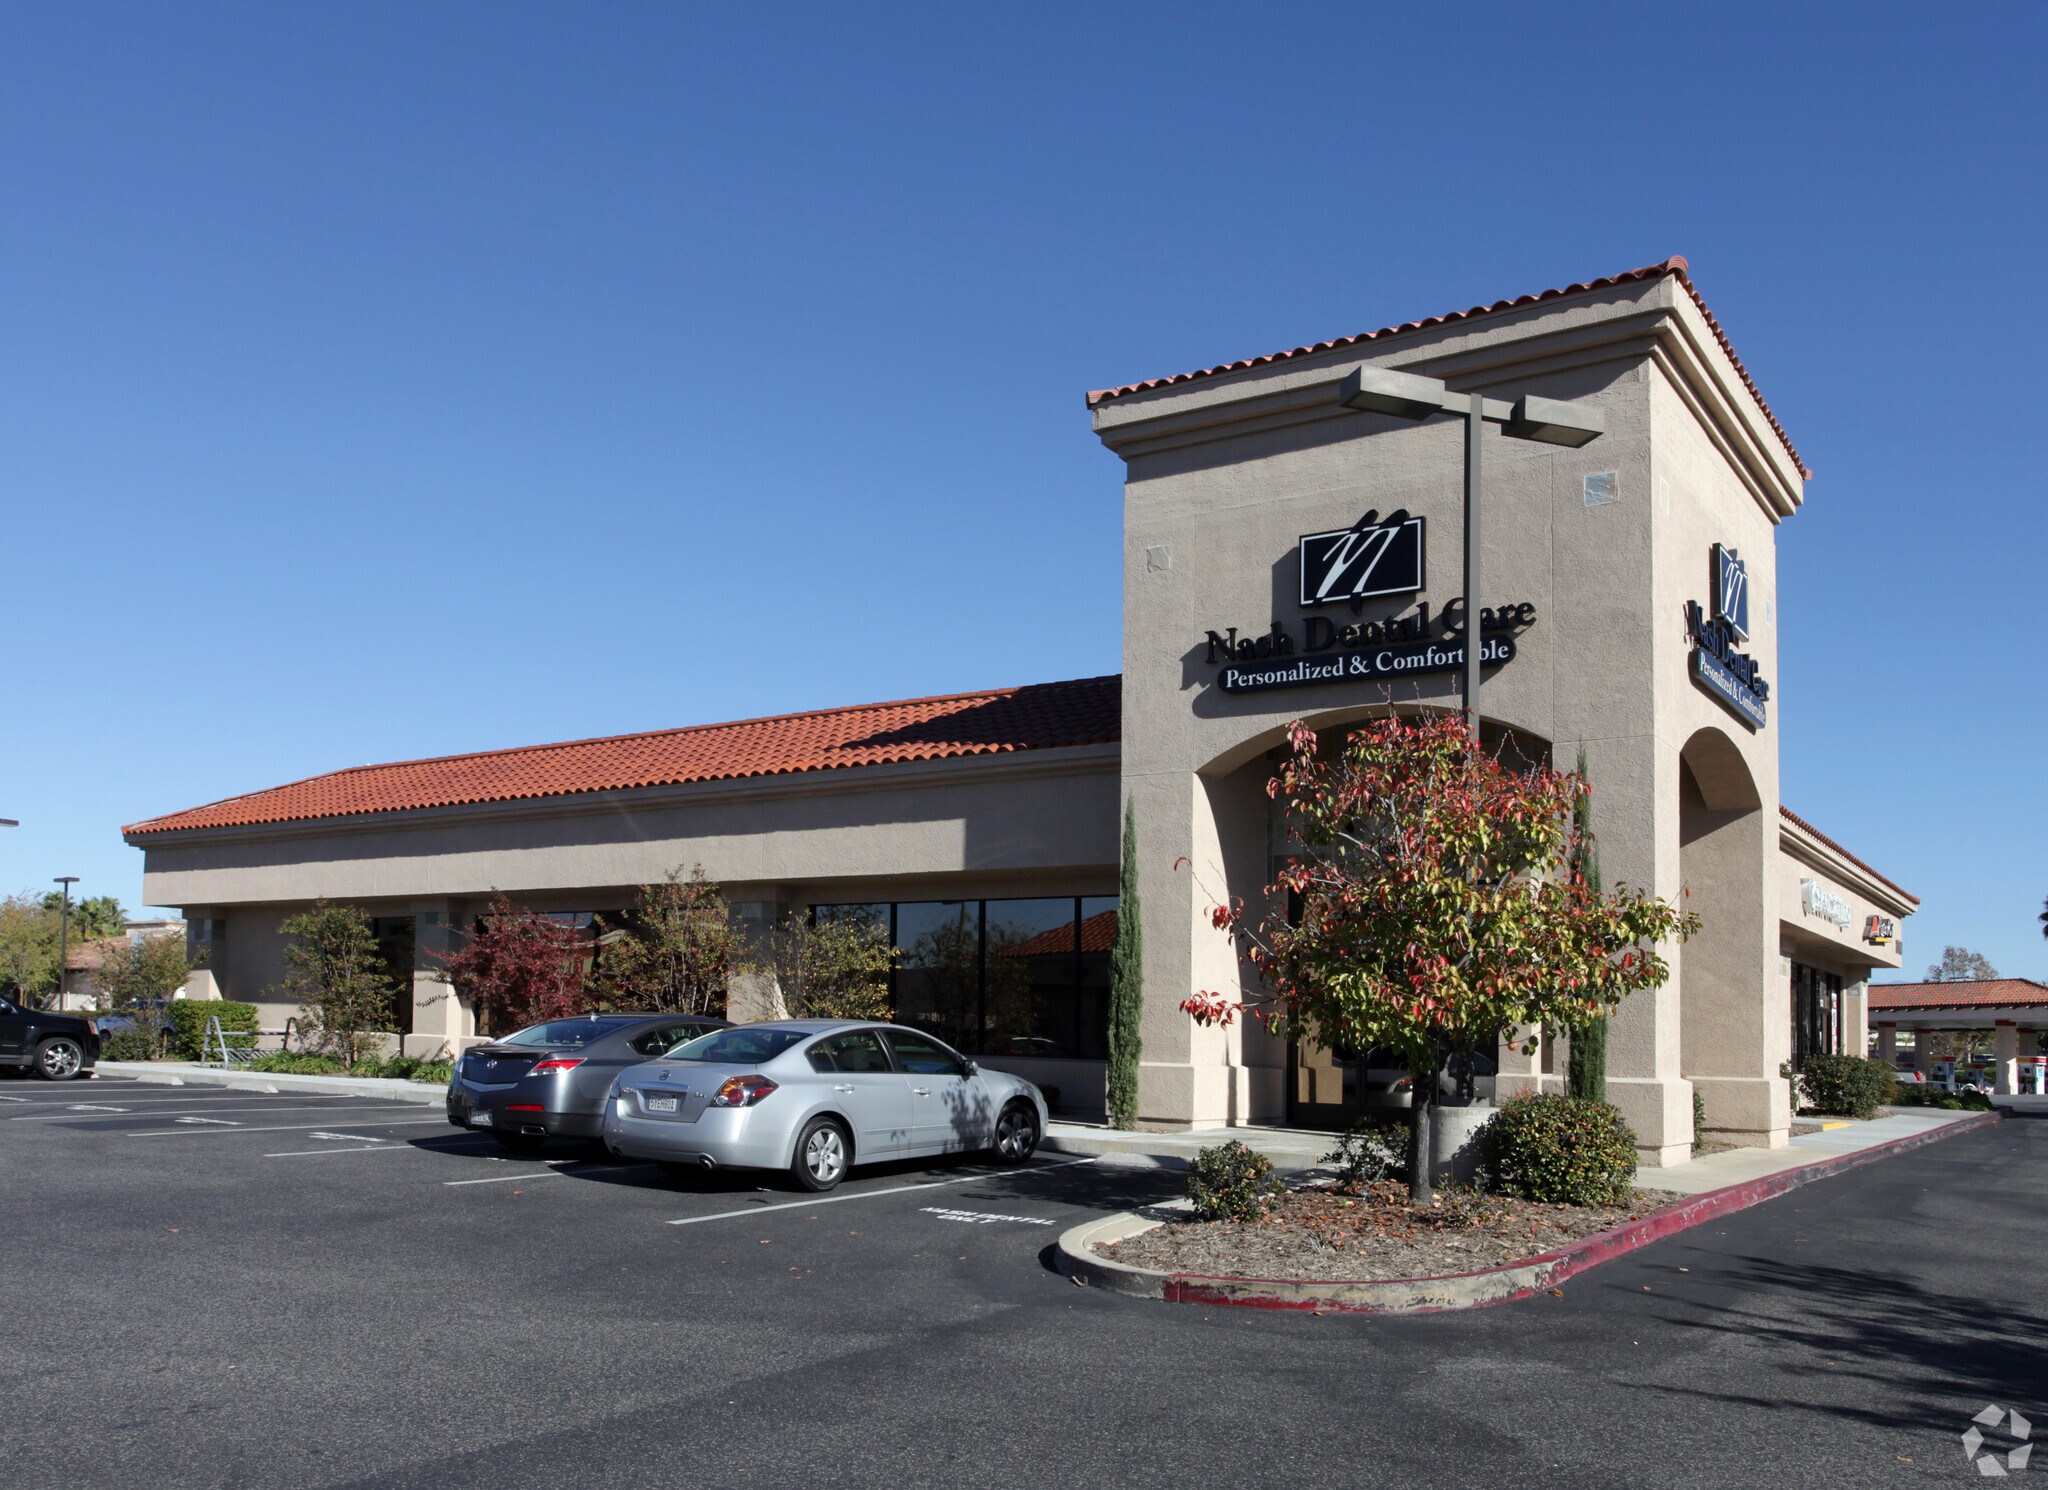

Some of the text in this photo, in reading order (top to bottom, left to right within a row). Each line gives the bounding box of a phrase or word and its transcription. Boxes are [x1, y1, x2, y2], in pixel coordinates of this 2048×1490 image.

[1204, 597, 1537, 664] Nash Dental Care
[1225, 639, 1510, 688] Personalized & Comfortble
